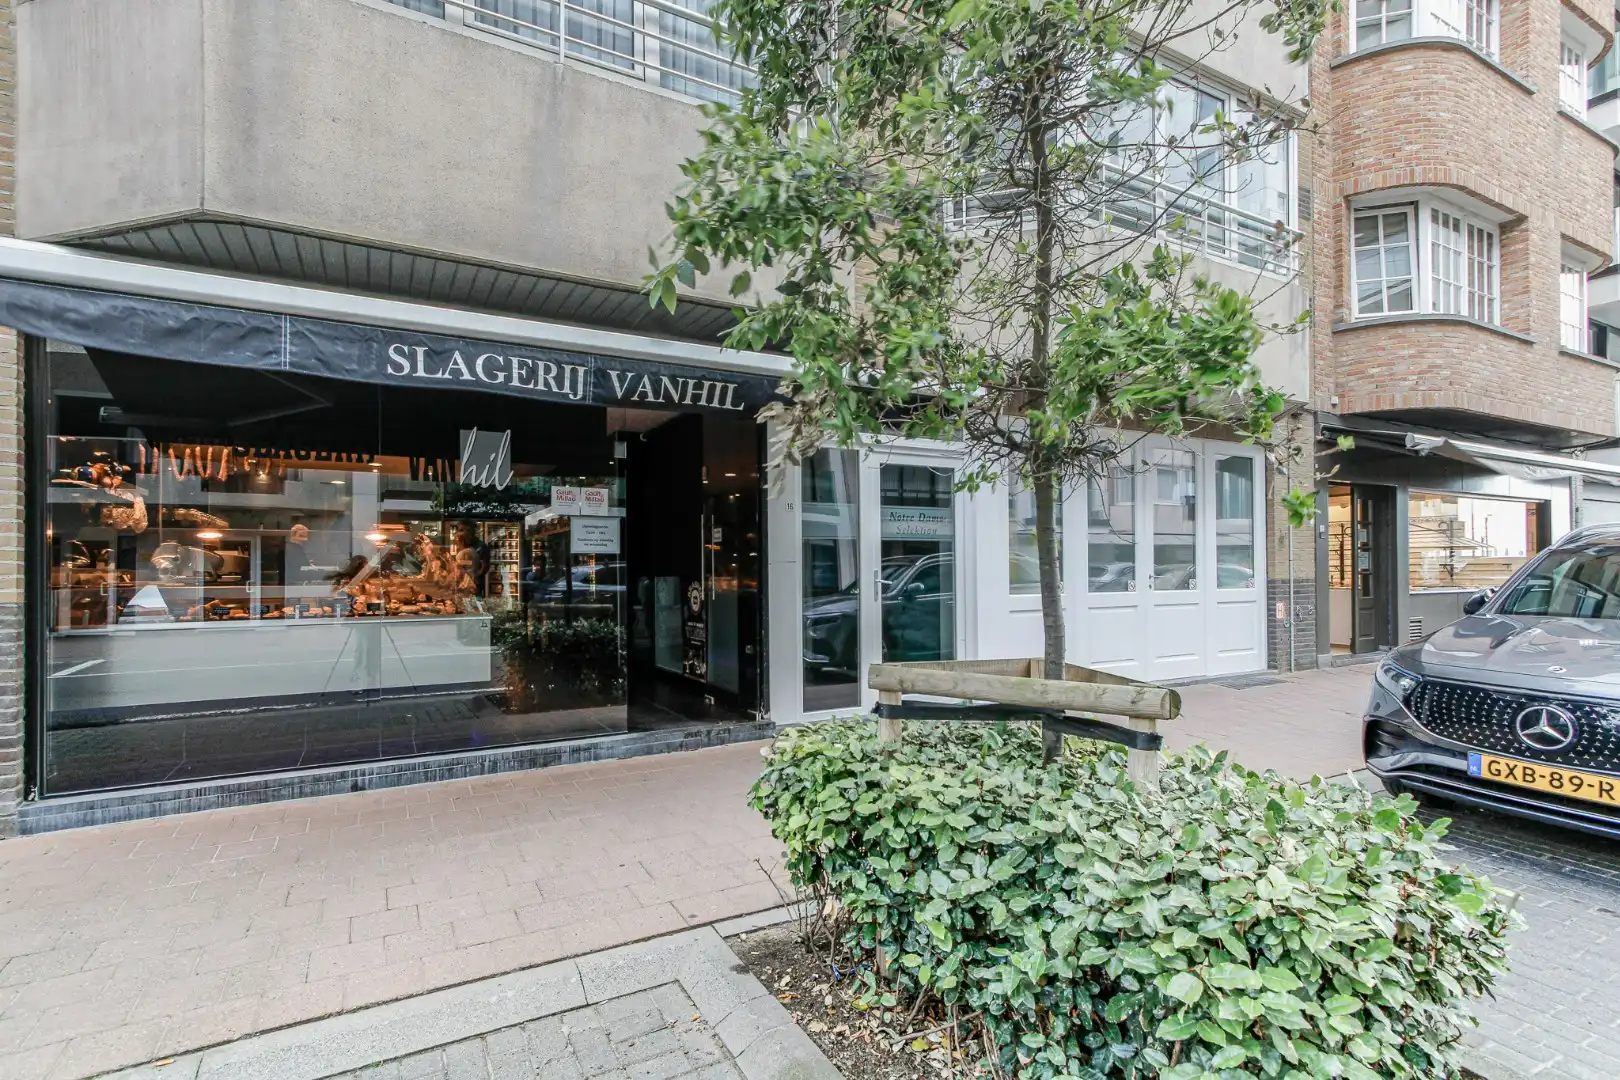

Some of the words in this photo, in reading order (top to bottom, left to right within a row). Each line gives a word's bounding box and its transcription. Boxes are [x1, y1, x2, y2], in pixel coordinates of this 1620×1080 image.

[386, 342, 589, 400] SLAGERIJ
[606, 368, 745, 412] VANHIL
[460, 426, 515, 491] hil
[888, 511, 915, 522] Notre
[1487, 759, 1616, 801] GXB-89-R
